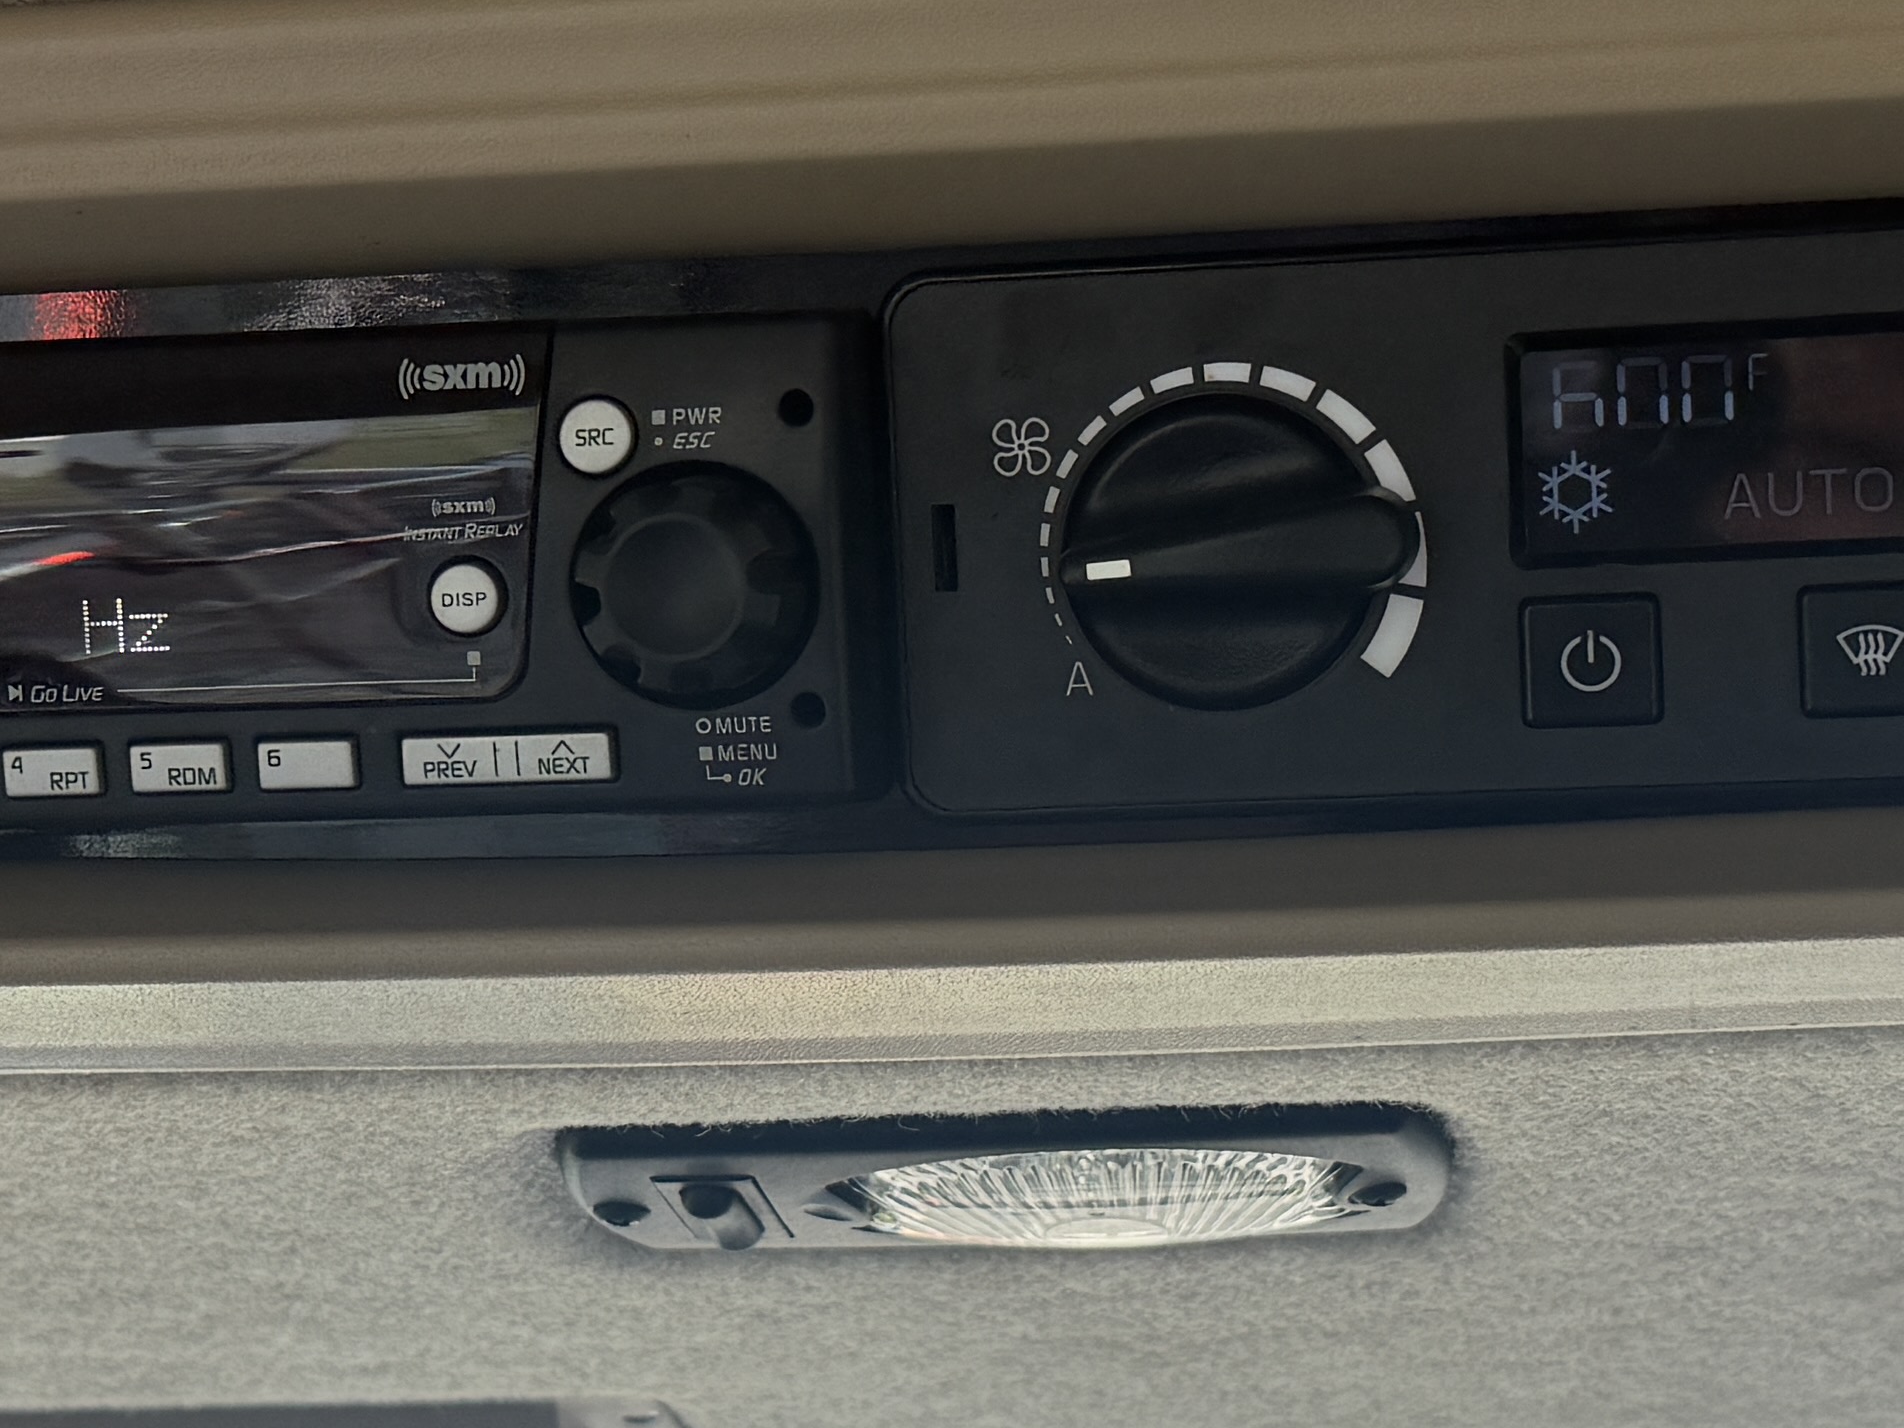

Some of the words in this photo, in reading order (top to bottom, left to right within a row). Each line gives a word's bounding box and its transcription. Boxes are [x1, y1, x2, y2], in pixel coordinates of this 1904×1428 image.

[672, 406, 722, 427] PWR
[574, 427, 615, 448] SRC
[672, 431, 716, 449] ESC
[1723, 466, 1895, 520] AUTO
[464, 523, 523, 539] REPLAY
[441, 591, 488, 608] DISP
[81, 597, 171, 655] Hz
[1065, 661, 1093, 696] A
[715, 716, 772, 735] MUTE
[139, 752, 152, 770] 5
[267, 749, 281, 767] 6
[717, 743, 778, 761] MENU
[11, 756, 24, 774] 4
[423, 759, 478, 779] PREV
[537, 756, 590, 776] NEXT
[50, 771, 90, 790] RPT
[168, 767, 217, 786] RDM
[738, 768, 767, 786] OK
